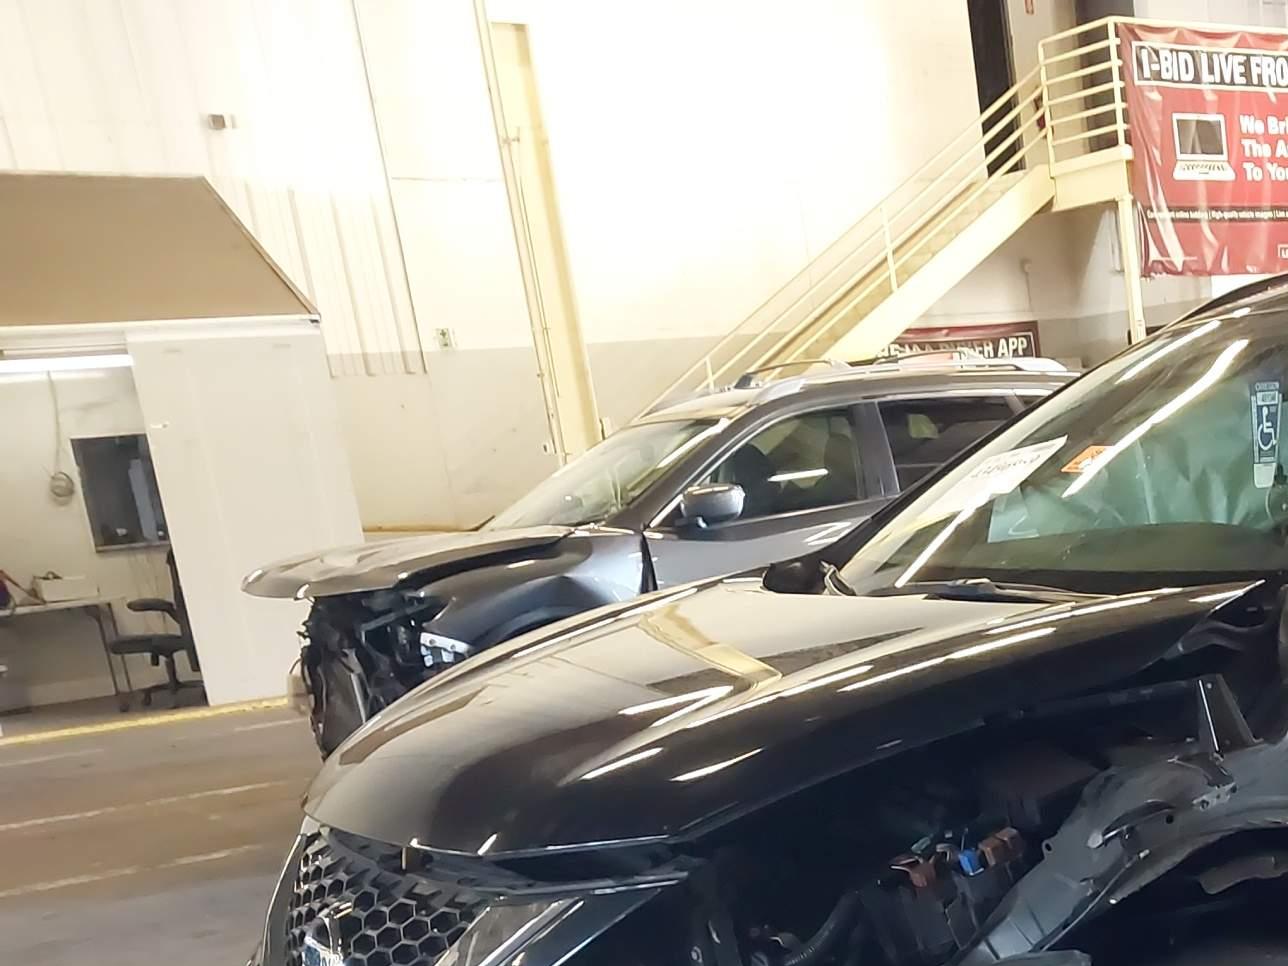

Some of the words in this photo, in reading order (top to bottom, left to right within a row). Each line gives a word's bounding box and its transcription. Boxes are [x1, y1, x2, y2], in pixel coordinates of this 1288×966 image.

[1141, 48, 1195, 82] I-BID
[1201, 52, 1247, 86] LIVE
[1240, 114, 1265, 135] We
[1241, 138, 1272, 158] The
[1243, 161, 1264, 181] To
[997, 336, 1028, 359] APP
